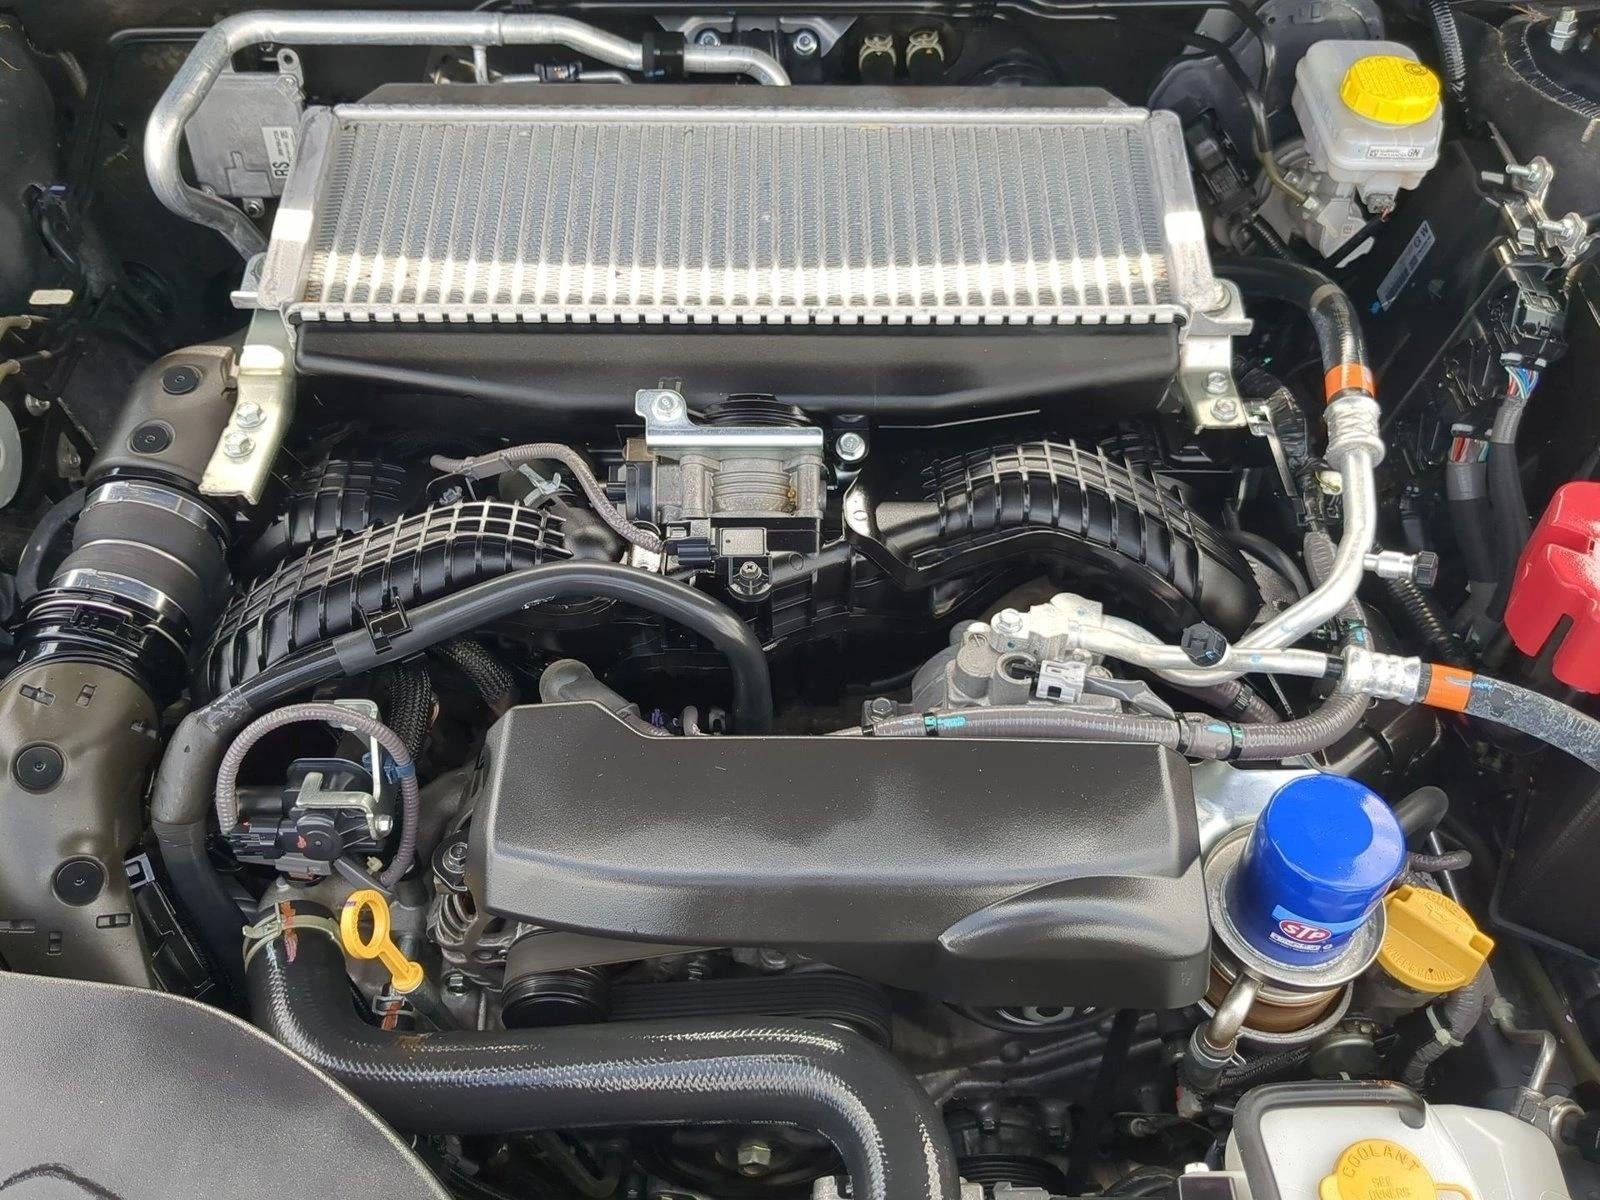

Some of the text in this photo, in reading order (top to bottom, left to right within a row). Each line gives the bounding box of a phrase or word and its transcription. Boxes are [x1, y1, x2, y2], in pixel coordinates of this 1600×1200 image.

[1284, 924, 1327, 941] STP
[1342, 1143, 1420, 1178] COOLANT
[1370, 1175, 1392, 1189] SEE
